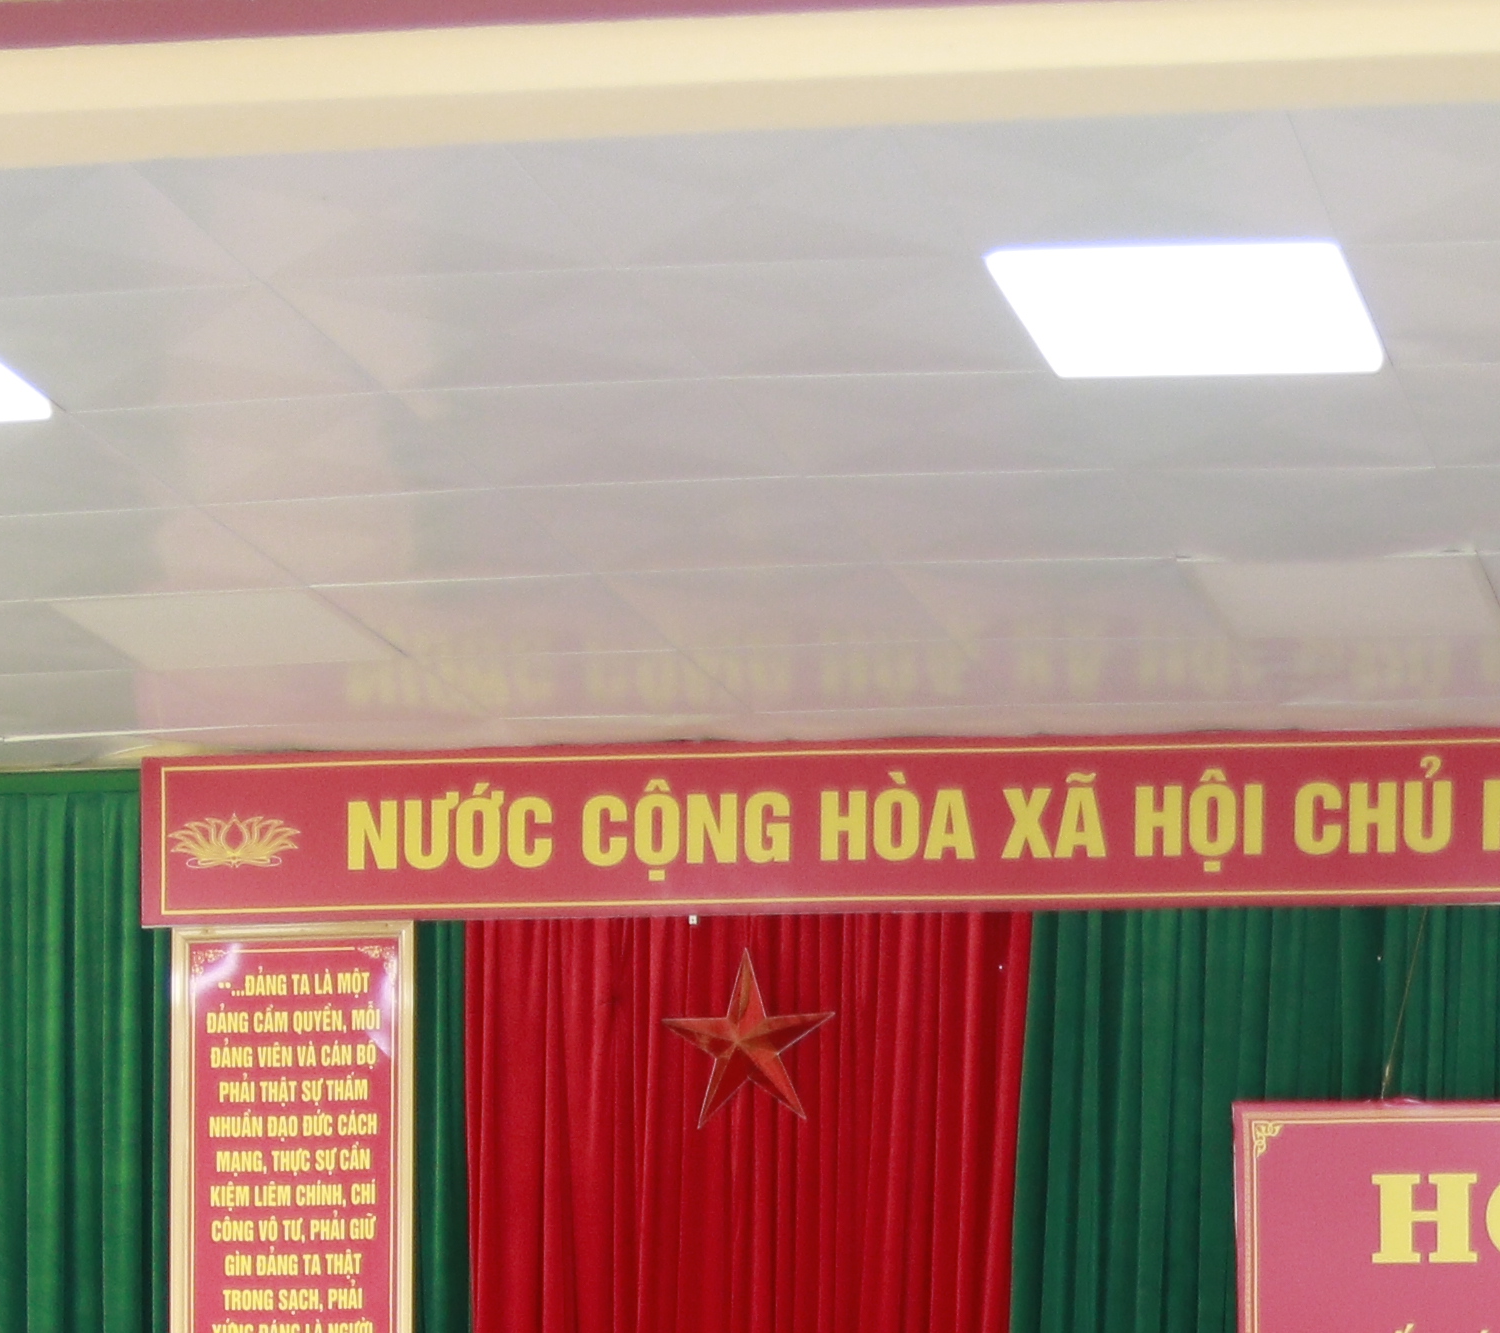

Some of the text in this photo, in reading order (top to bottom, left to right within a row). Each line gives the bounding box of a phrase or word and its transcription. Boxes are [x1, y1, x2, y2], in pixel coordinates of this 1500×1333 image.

[347, 782, 553, 871] NƯỚC
[581, 778, 791, 882] CỘNG
[820, 771, 976, 862] HÒA
[1001, 772, 1107, 859] XÃ
[1134, 768, 1264, 873] HỘI
[1294, 755, 1453, 856] CHỦ
[292, 974, 310, 995] TA
[315, 969, 332, 994] LÀ
[338, 970, 369, 998] MỘT
[207, 1000, 382, 1034] ĐẢNG CẦM QUYỀN, MỖI
[211, 1038, 378, 1069] ĐẢNG VIÊN VÀ CÁN BỘ
[220, 1073, 368, 1106] PHẢI THẬT SỰ THẤM
[210, 1109, 377, 1141] NHUẦN ĐẠO ĐỨC CÁCH
[217, 1142, 370, 1176] MẠNG, THỰC SỰ CẦN
[211, 1179, 375, 1211] KIỆM LIÊM CHÍNH, CHÍ
[212, 1210, 376, 1243] CÔNG VÔ TƯ, PHẢI GIỮ
[225, 1246, 361, 1279] GÌN ĐẢNG TA THẬT
[223, 1279, 362, 1315] TRONG SẠCH, PHẢI
